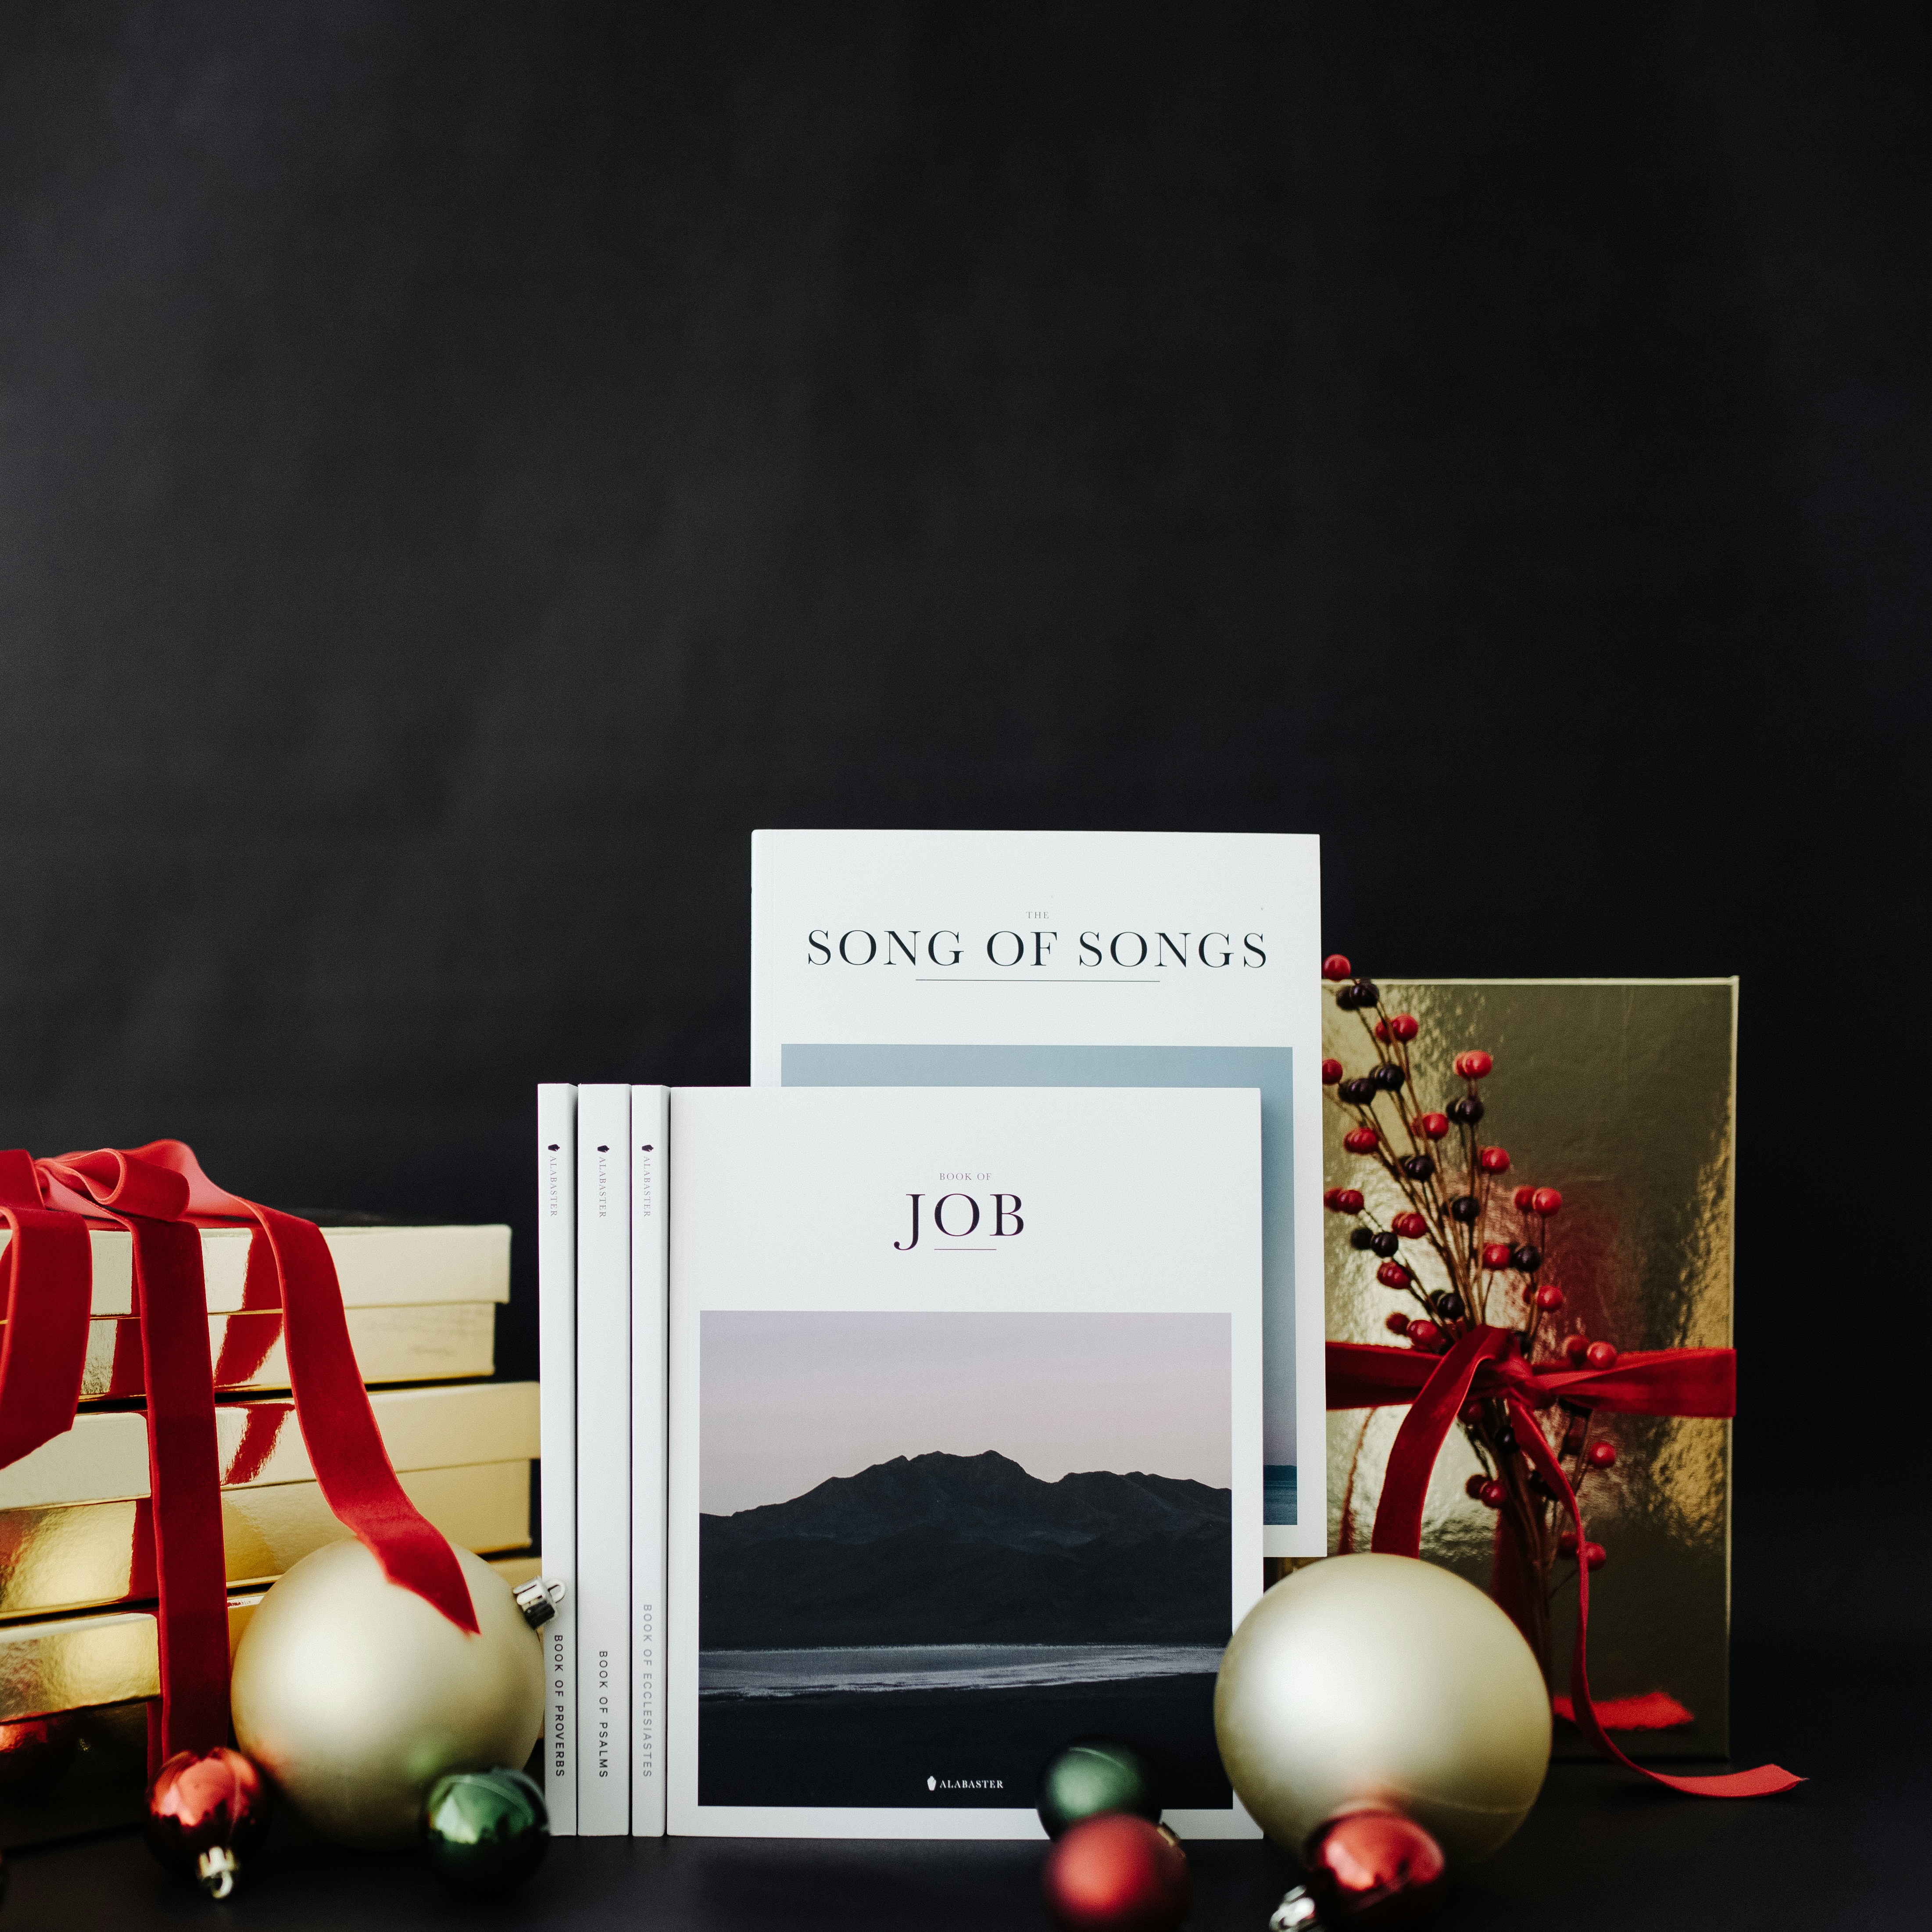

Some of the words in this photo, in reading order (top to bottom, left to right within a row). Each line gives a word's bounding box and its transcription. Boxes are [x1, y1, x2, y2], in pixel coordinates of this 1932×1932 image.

[807, 929, 964, 967] SONG
[986, 930, 1058, 967] OF
[1078, 931, 1267, 969] SONGS
[893, 1193, 1024, 1251] JOB
[644, 1604, 652, 1642] BOOK
[554, 1635, 563, 1672] BOOK
[599, 1651, 608, 1689] BOOK
[643, 1649, 652, 1666] OF
[555, 1680, 564, 1697] OF
[599, 1697, 608, 1714] OF
[555, 1705, 565, 1777] PROVERBS
[643, 1673, 652, 1777] ECCLESIASTES
[599, 1722, 608, 1778] PSALMS
[939, 1780, 1004, 1789] ALABASTER
